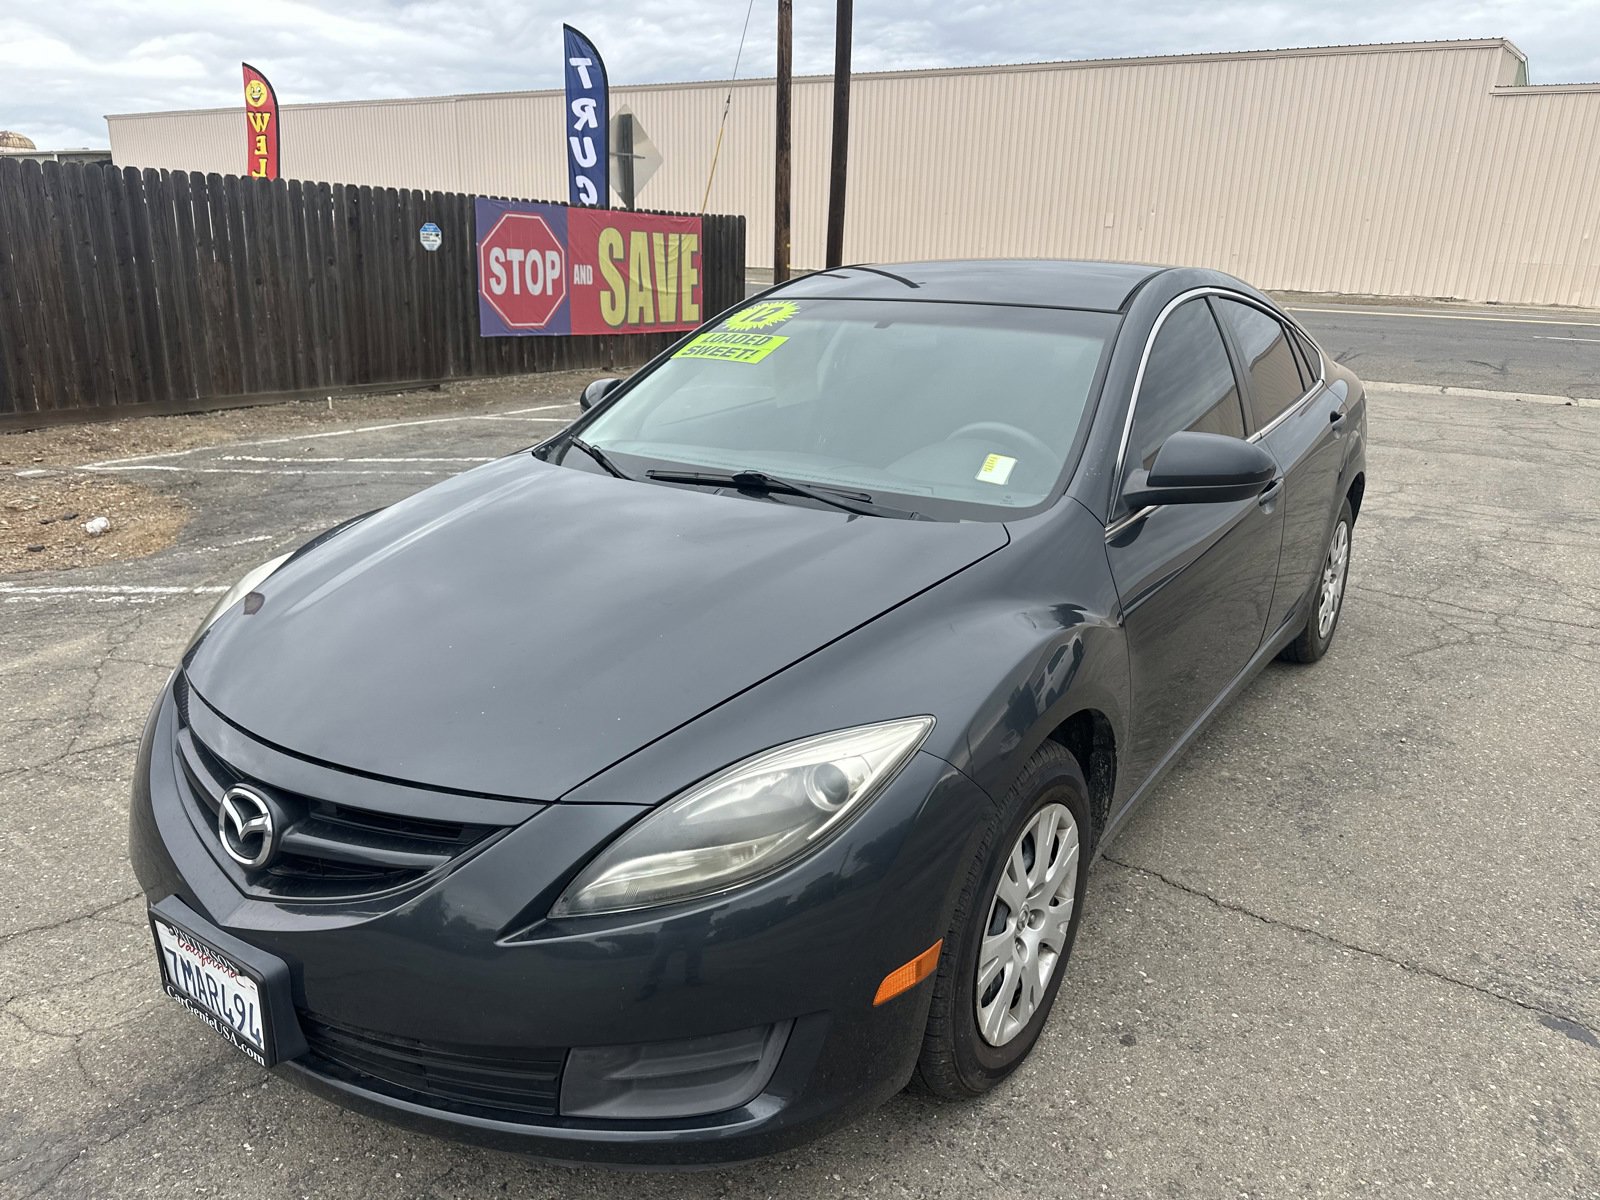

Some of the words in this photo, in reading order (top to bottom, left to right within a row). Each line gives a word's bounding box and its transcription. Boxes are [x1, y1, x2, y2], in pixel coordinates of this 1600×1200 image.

[489, 246, 561, 296] STOP
[573, 264, 593, 285] AND
[598, 227, 700, 327] SAVE
[681, 345, 761, 359] SWEET!
[702, 333, 773, 346] LOADED
[164, 946, 262, 1047] 7MAR494
[166, 985, 265, 1067] CarGenieUSA.com
